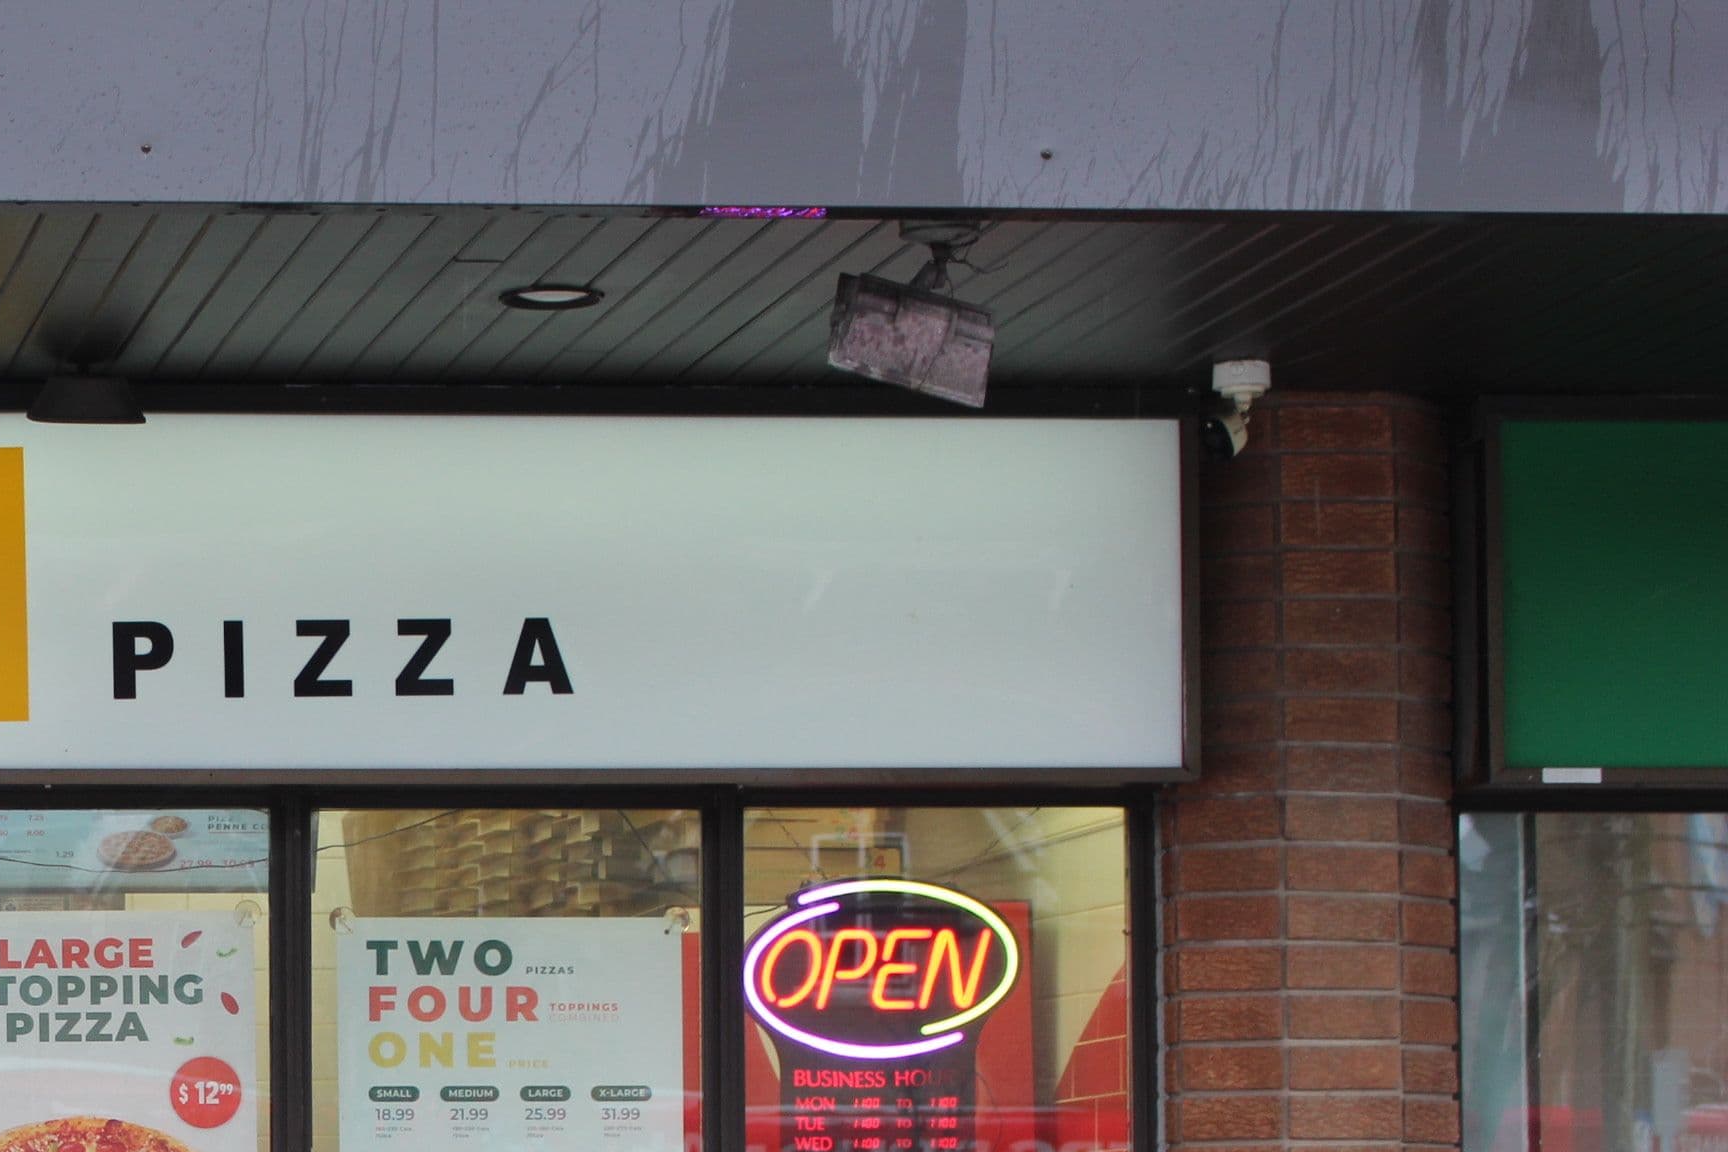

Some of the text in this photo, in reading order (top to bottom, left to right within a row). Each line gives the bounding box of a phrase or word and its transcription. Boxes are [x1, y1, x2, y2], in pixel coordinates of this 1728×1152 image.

[112, 617, 575, 700] PIZZA
[366, 939, 575, 976] TWO PIZZAS
[761, 928, 992, 1011] OPEN
[368, 986, 619, 1023] FOUR TOPPINGS
[5, 1011, 149, 1043] PIZZA
[368, 1031, 550, 1069] ONE PRICE
[792, 1069, 886, 1088] BUSINESS
[376, 1088, 412, 1098] SMALL
[448, 1088, 494, 1098] MEDIUM
[528, 1088, 564, 1098] LARGE
[599, 1088, 646, 1098] X-LARGE
[375, 1108, 415, 1121] 18.99
[450, 1108, 489, 1121] 21.99
[524, 1108, 566, 1121] 25.99
[601, 1108, 641, 1121] 31.99
[794, 1117, 825, 1131] TUE
[794, 1137, 833, 1151] WED
